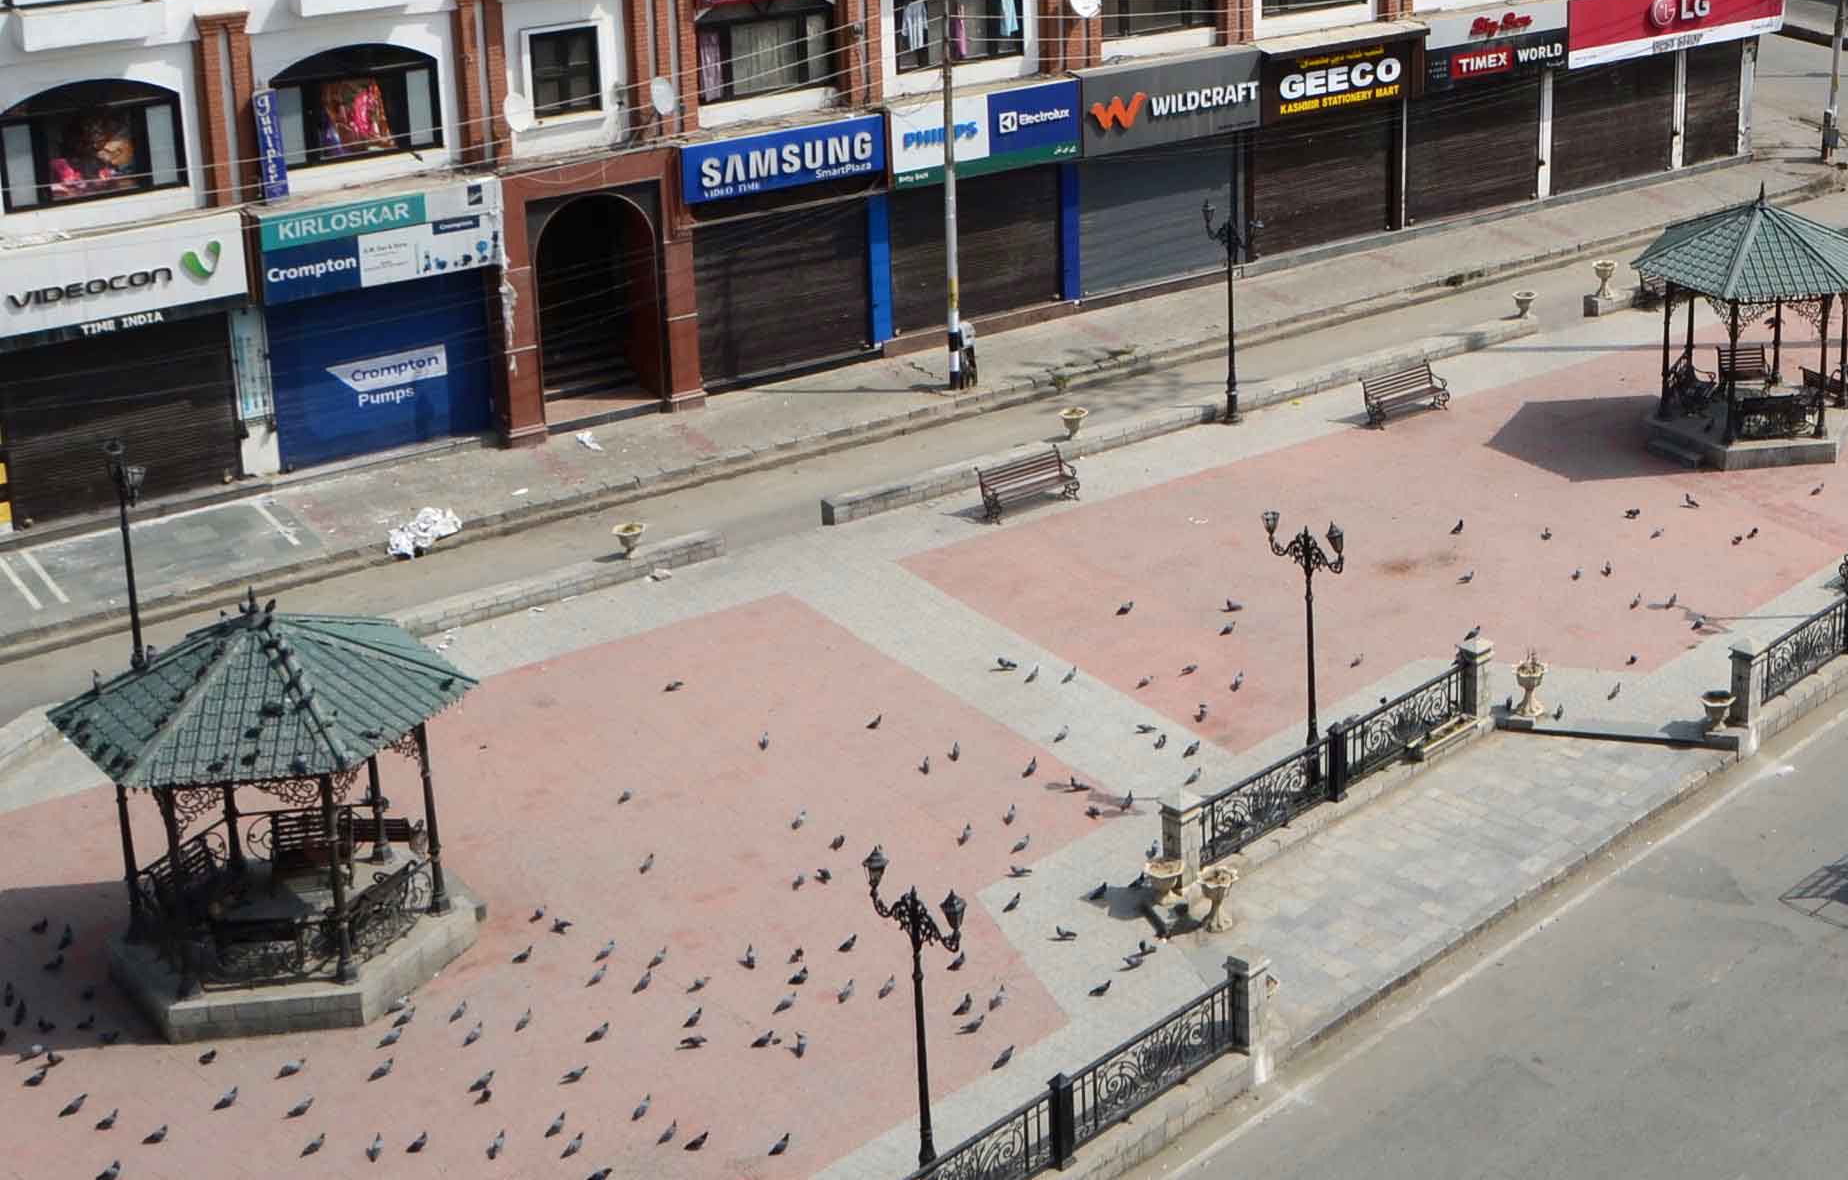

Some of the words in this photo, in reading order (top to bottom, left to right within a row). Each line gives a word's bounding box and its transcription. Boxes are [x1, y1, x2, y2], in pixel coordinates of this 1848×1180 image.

[1458, 51, 1508, 73] TIMEX
[1517, 43, 1563, 62] WORLD
[1280, 57, 1401, 100] GEECO
[1152, 81, 1259, 117] WILDCRAFT
[1280, 99, 1320, 115] KASHMIR
[1321, 90, 1373, 107] STATIONERY
[1375, 84, 1400, 98] MART
[1019, 107, 1070, 126] Electrolux
[903, 121, 978, 150] PHILPS
[701, 132, 872, 188] SAMSUNG
[278, 203, 410, 240] KIRLOSKAR
[266, 254, 357, 283] Crompton
[80, 319, 117, 336] TIME
[122, 310, 164, 329] INDIA
[351, 354, 439, 383] Crompton
[357, 385, 416, 408] Pumps
